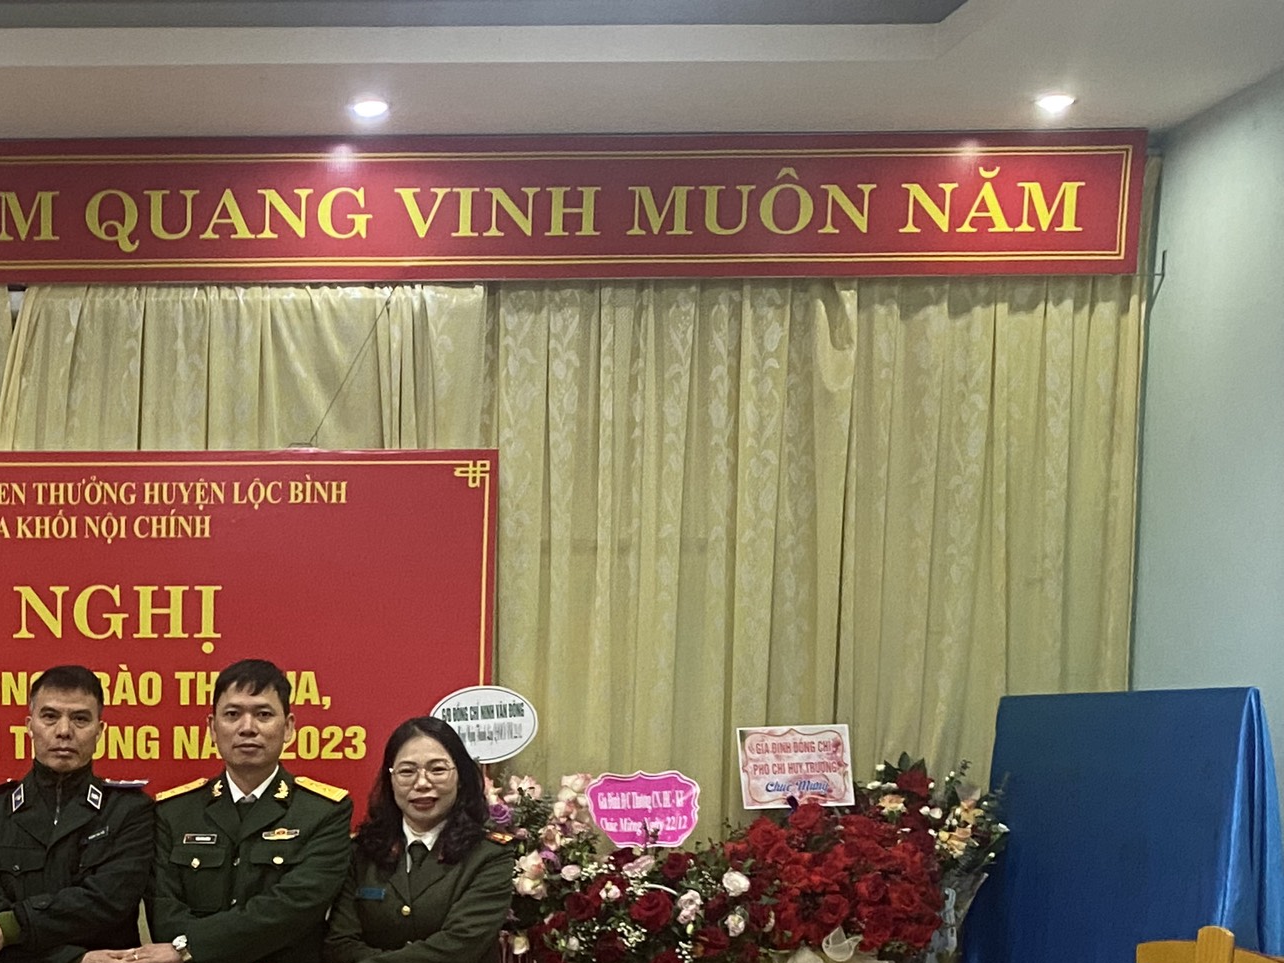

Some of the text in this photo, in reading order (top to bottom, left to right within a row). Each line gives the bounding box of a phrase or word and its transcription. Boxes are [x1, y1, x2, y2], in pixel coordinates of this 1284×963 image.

[85, 186, 372, 252] QUANG
[394, 186, 602, 238] VINH
[626, 167, 876, 235] MUÔN
[899, 166, 1086, 233] NĂM
[33, 475, 136, 505] THƯỞNG
[144, 477, 226, 510] HUYỆN
[233, 477, 282, 510] LỘC
[288, 474, 348, 504] BÌNH
[16, 509, 77, 539] KHỐI
[84, 511, 127, 544] NỘI
[133, 508, 211, 538] CHÍNH
[13, 584, 222, 654] NGHỊ
[278, 725, 367, 760] 2023
